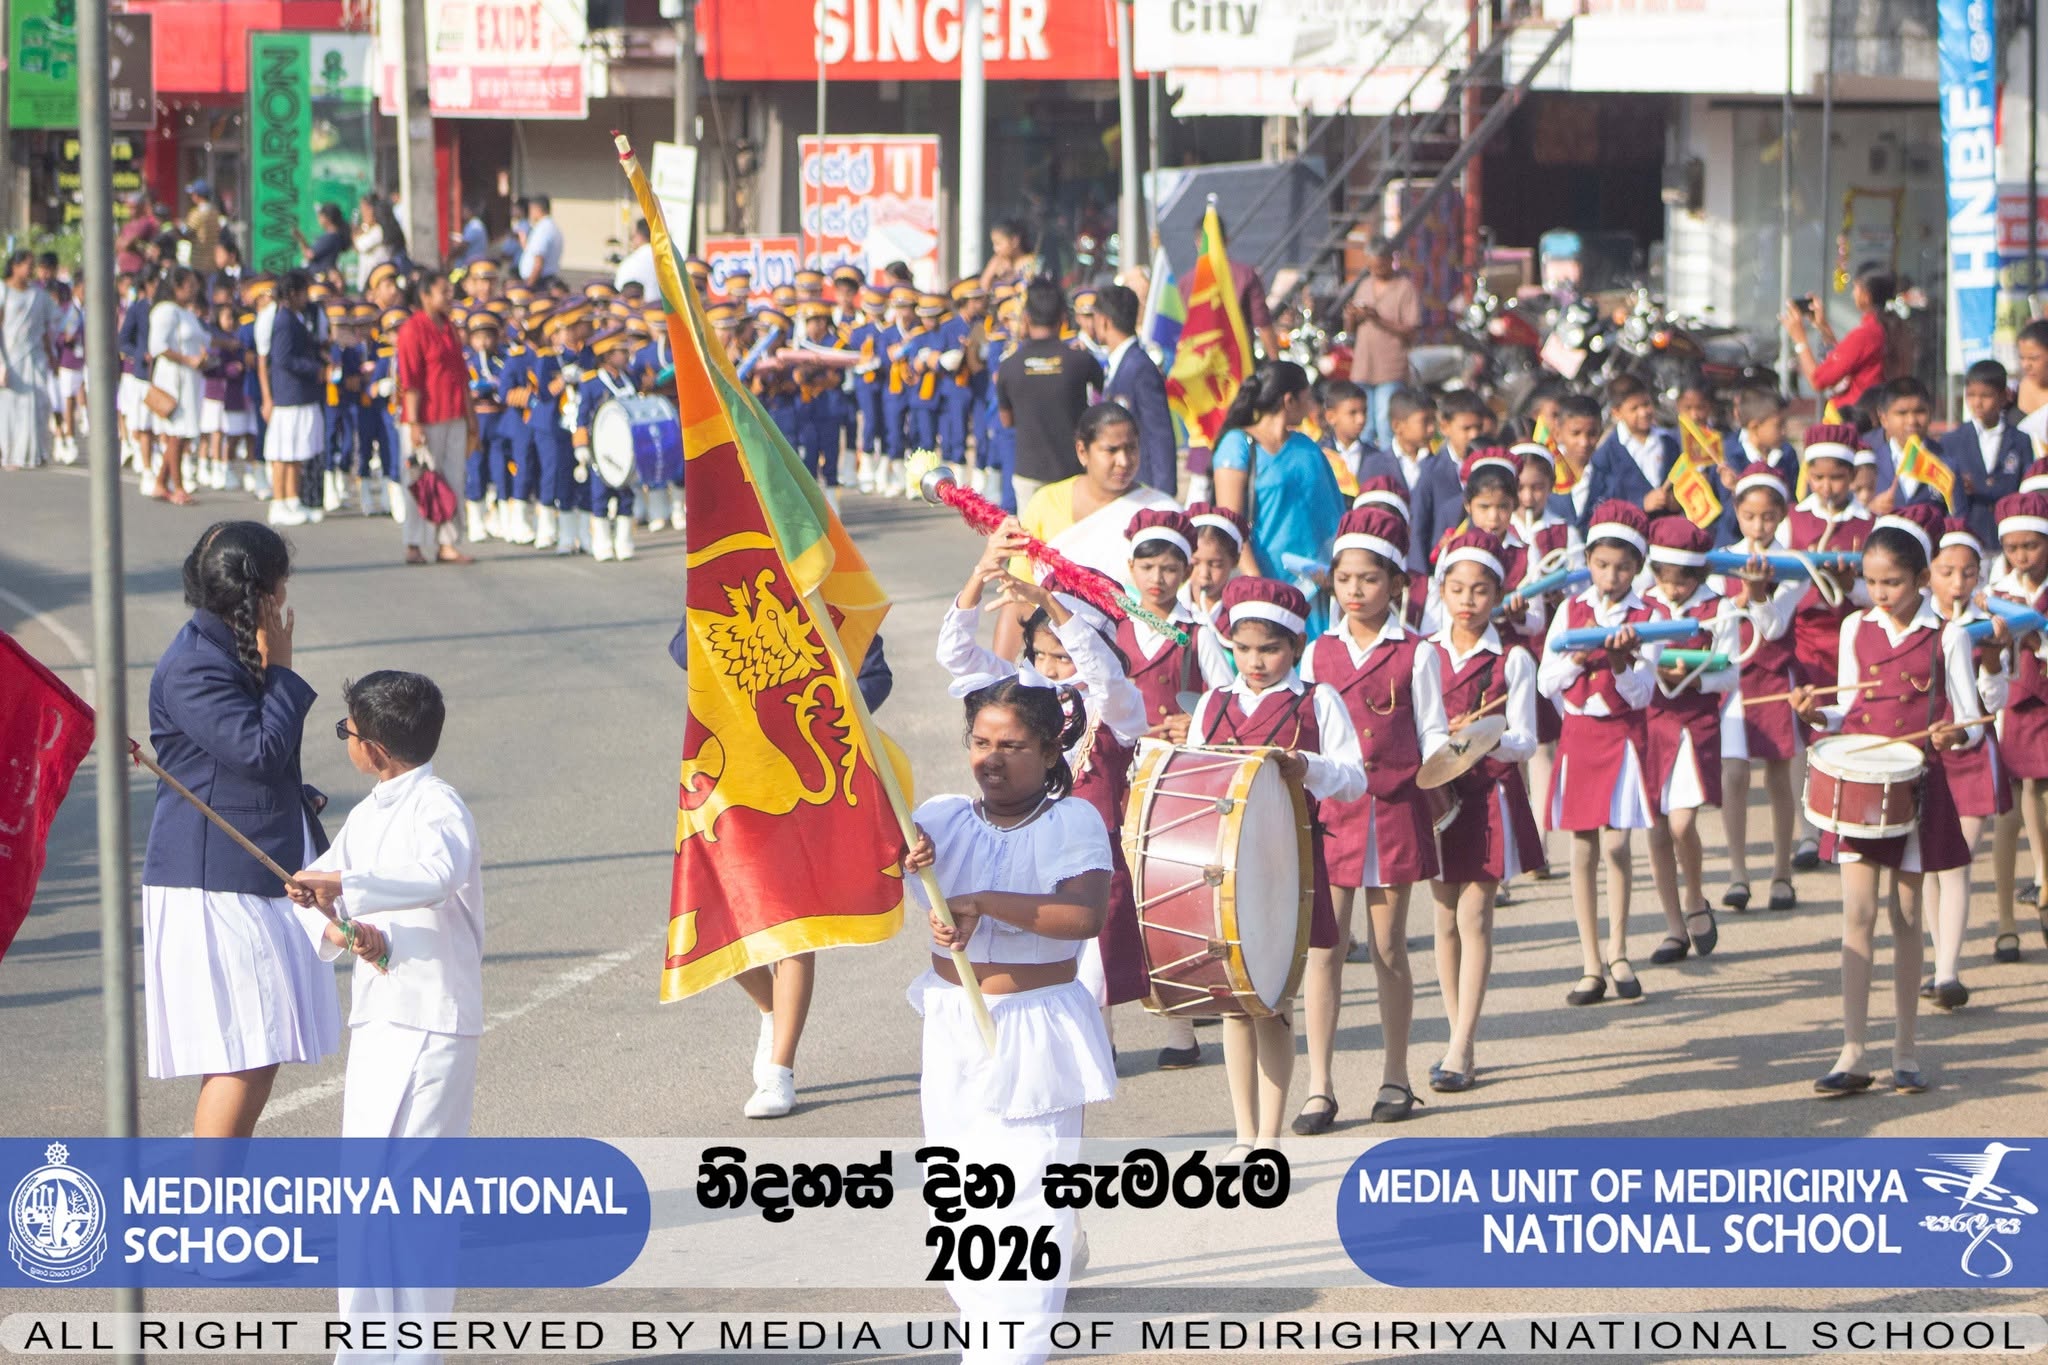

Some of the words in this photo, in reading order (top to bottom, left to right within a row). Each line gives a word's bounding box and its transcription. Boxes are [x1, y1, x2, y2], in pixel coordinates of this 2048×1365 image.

[475, 2, 541, 50] EXIDE
[814, 0, 1049, 63] SINGER
[1171, 0, 1257, 35] City
[261, 45, 301, 276] AMARON
[1949, 86, 1996, 289] HNBF
